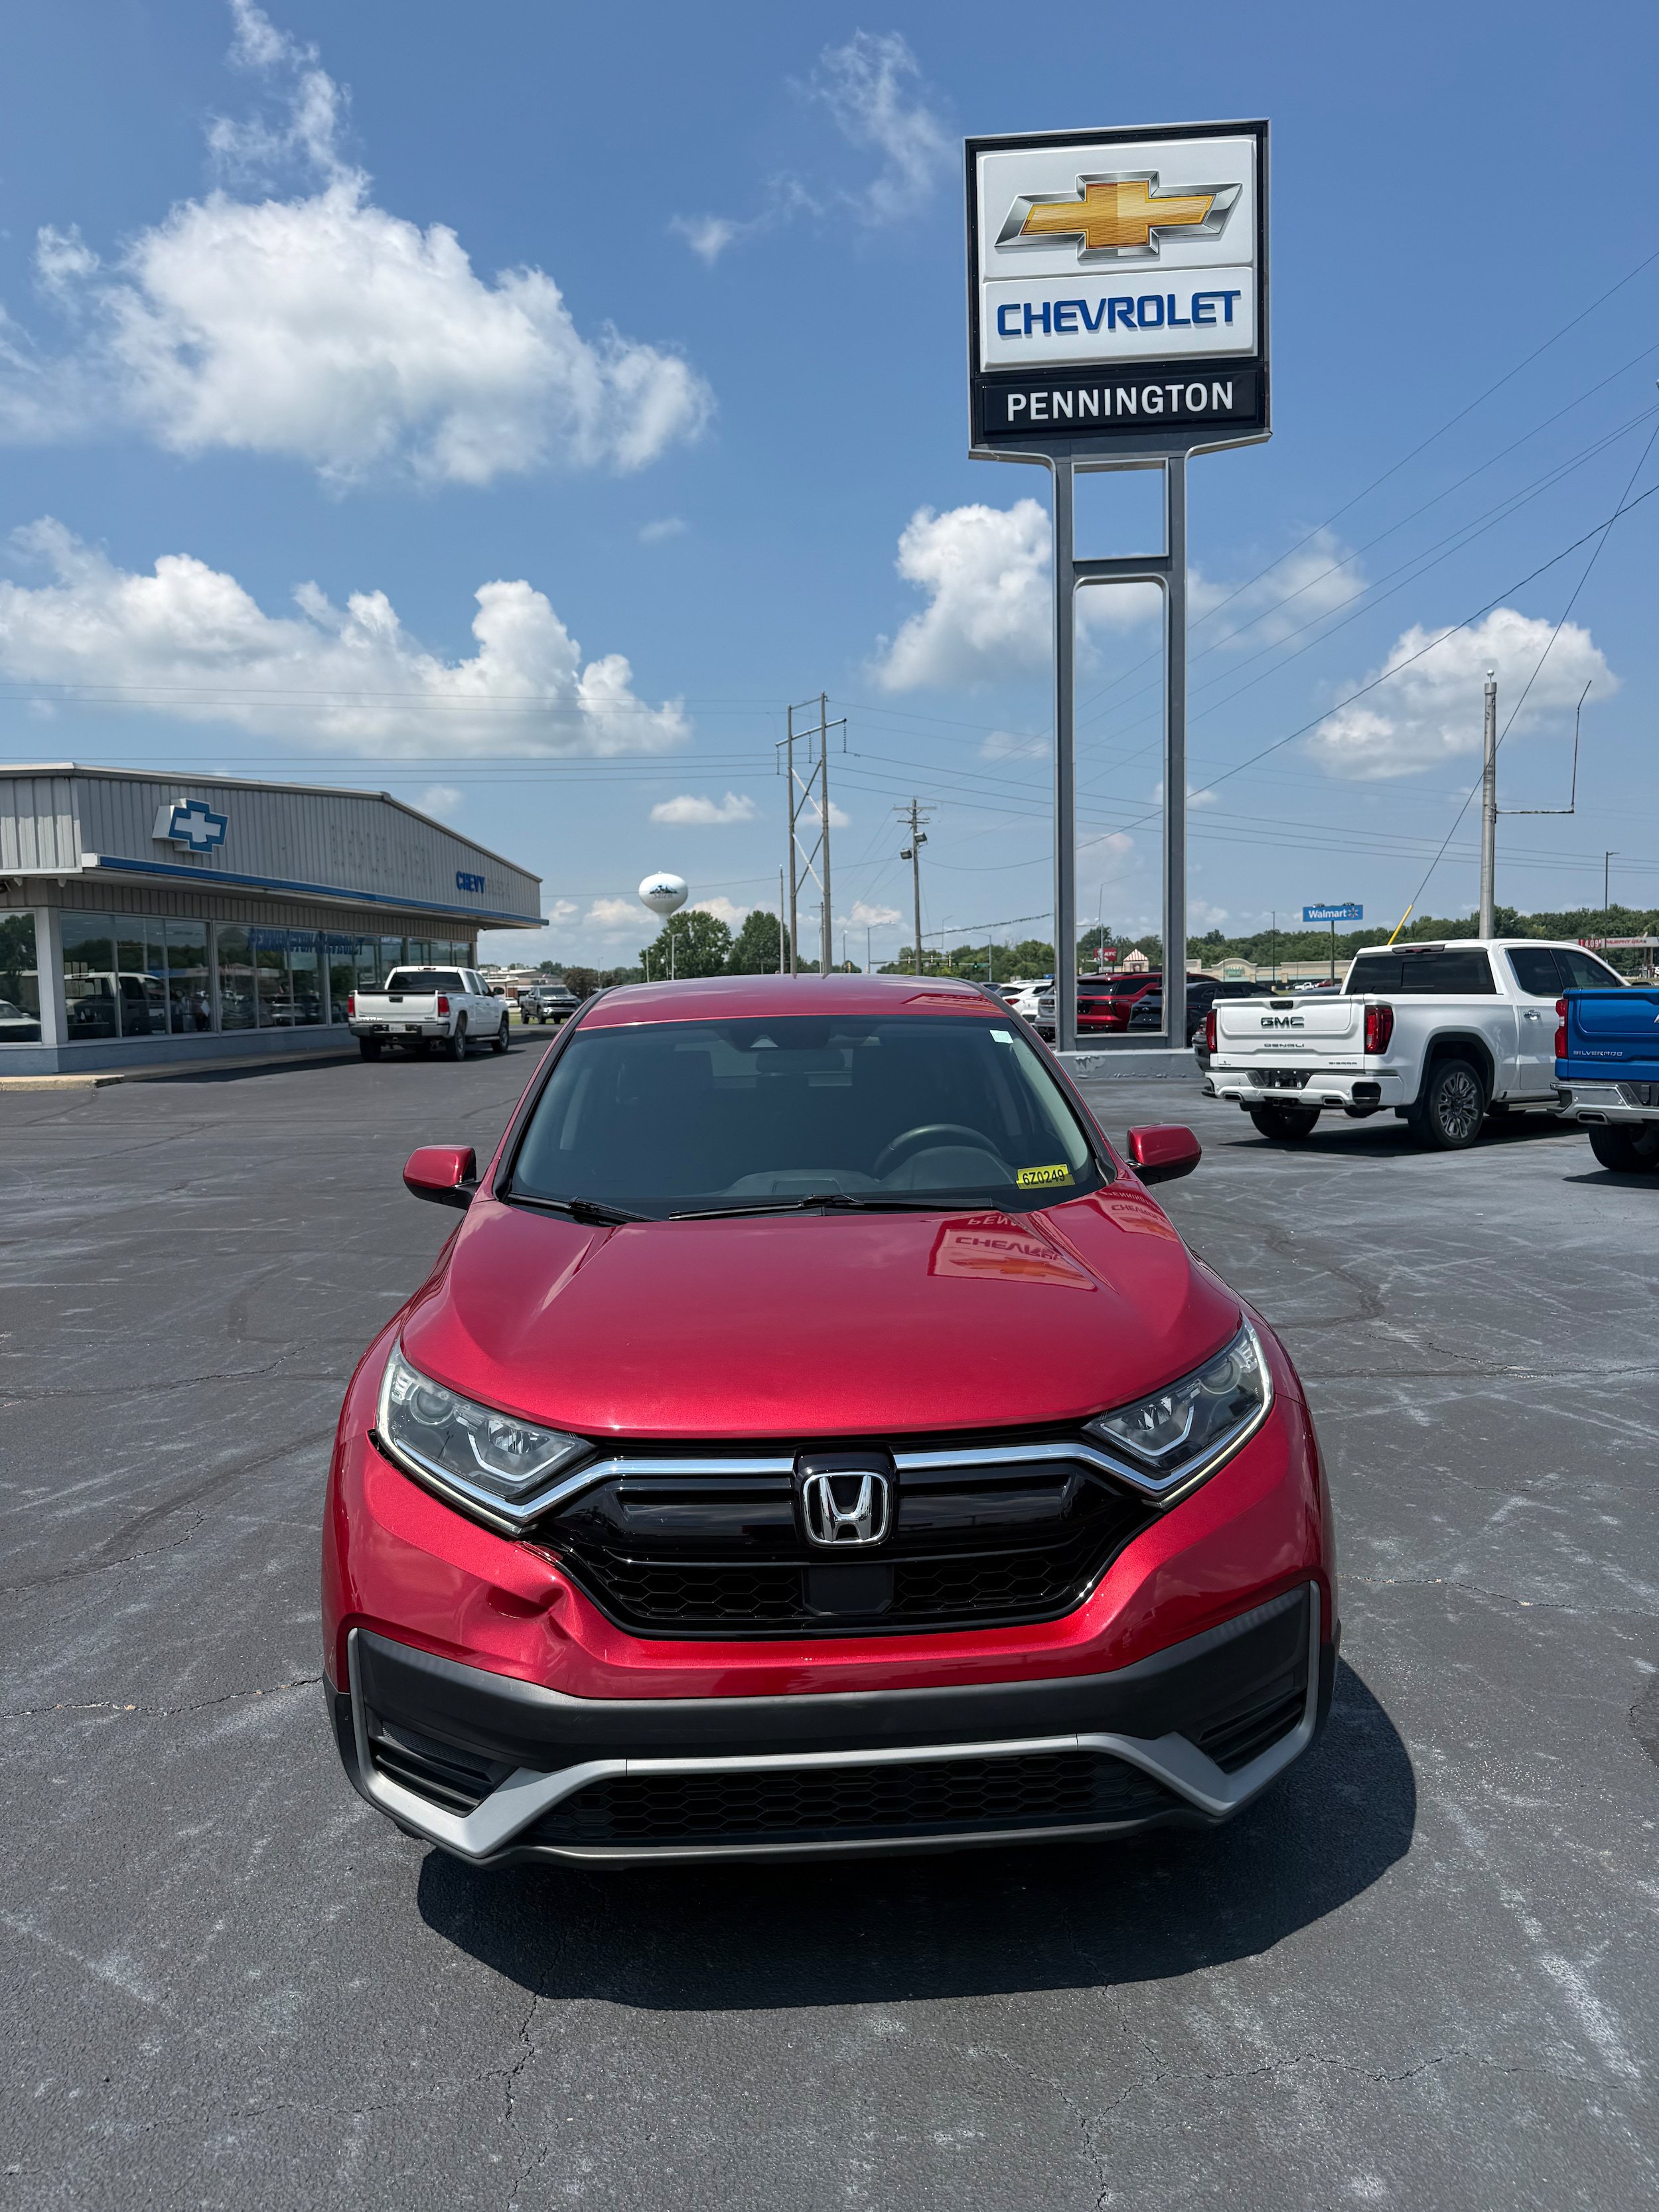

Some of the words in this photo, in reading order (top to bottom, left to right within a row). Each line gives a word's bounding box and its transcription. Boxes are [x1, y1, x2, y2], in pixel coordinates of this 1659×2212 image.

[997, 289, 1241, 335] CHEVROLET
[1007, 382, 1233, 421] PENNINGTON
[456, 871, 485, 893] CHEVY
[1308, 909, 1347, 919] Walmart
[1260, 1016, 1305, 1028] GMC
[1023, 1169, 1065, 1185] 6Z0249
